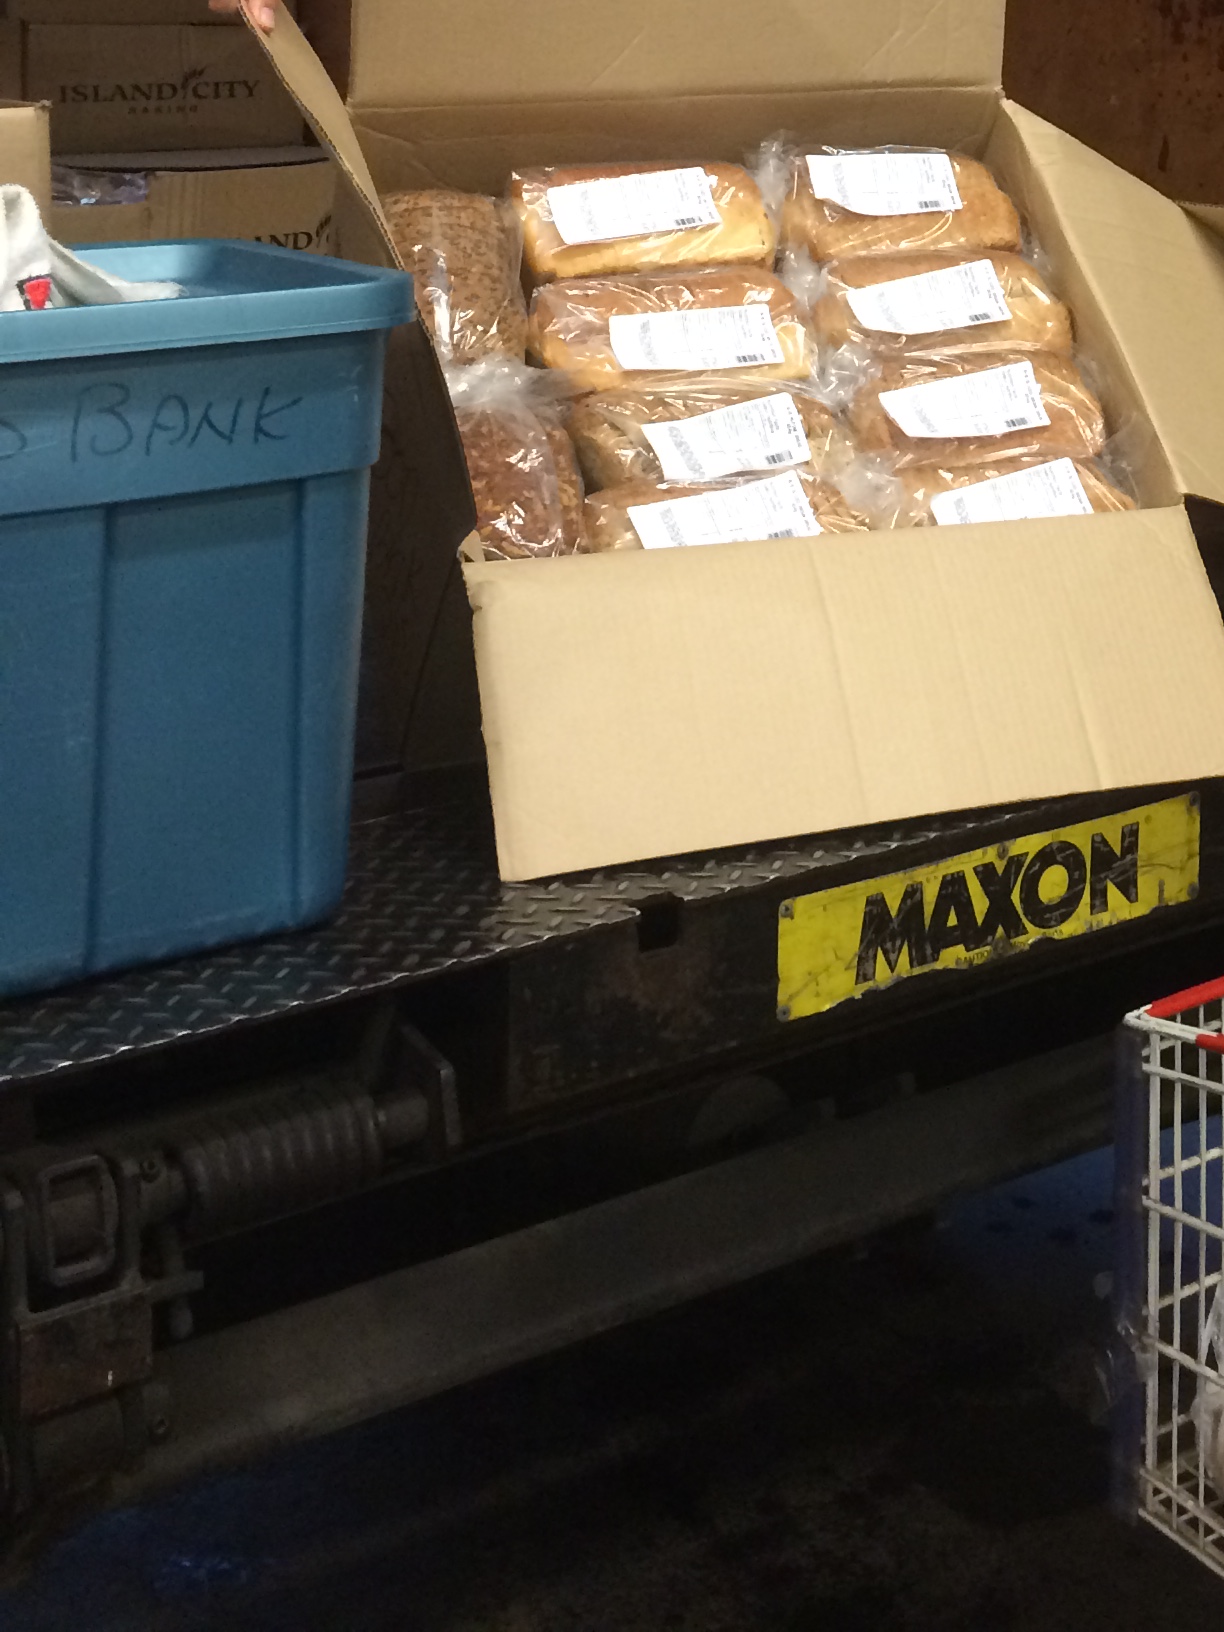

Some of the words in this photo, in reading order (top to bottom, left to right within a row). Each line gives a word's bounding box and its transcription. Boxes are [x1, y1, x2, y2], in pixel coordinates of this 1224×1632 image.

[58, 82, 179, 104] ISLAND
[192, 79, 261, 100] CITY
[127, 103, 199, 115] BAKING
[70, 382, 304, 464] BANK
[854, 821, 1140, 986] MAXON
